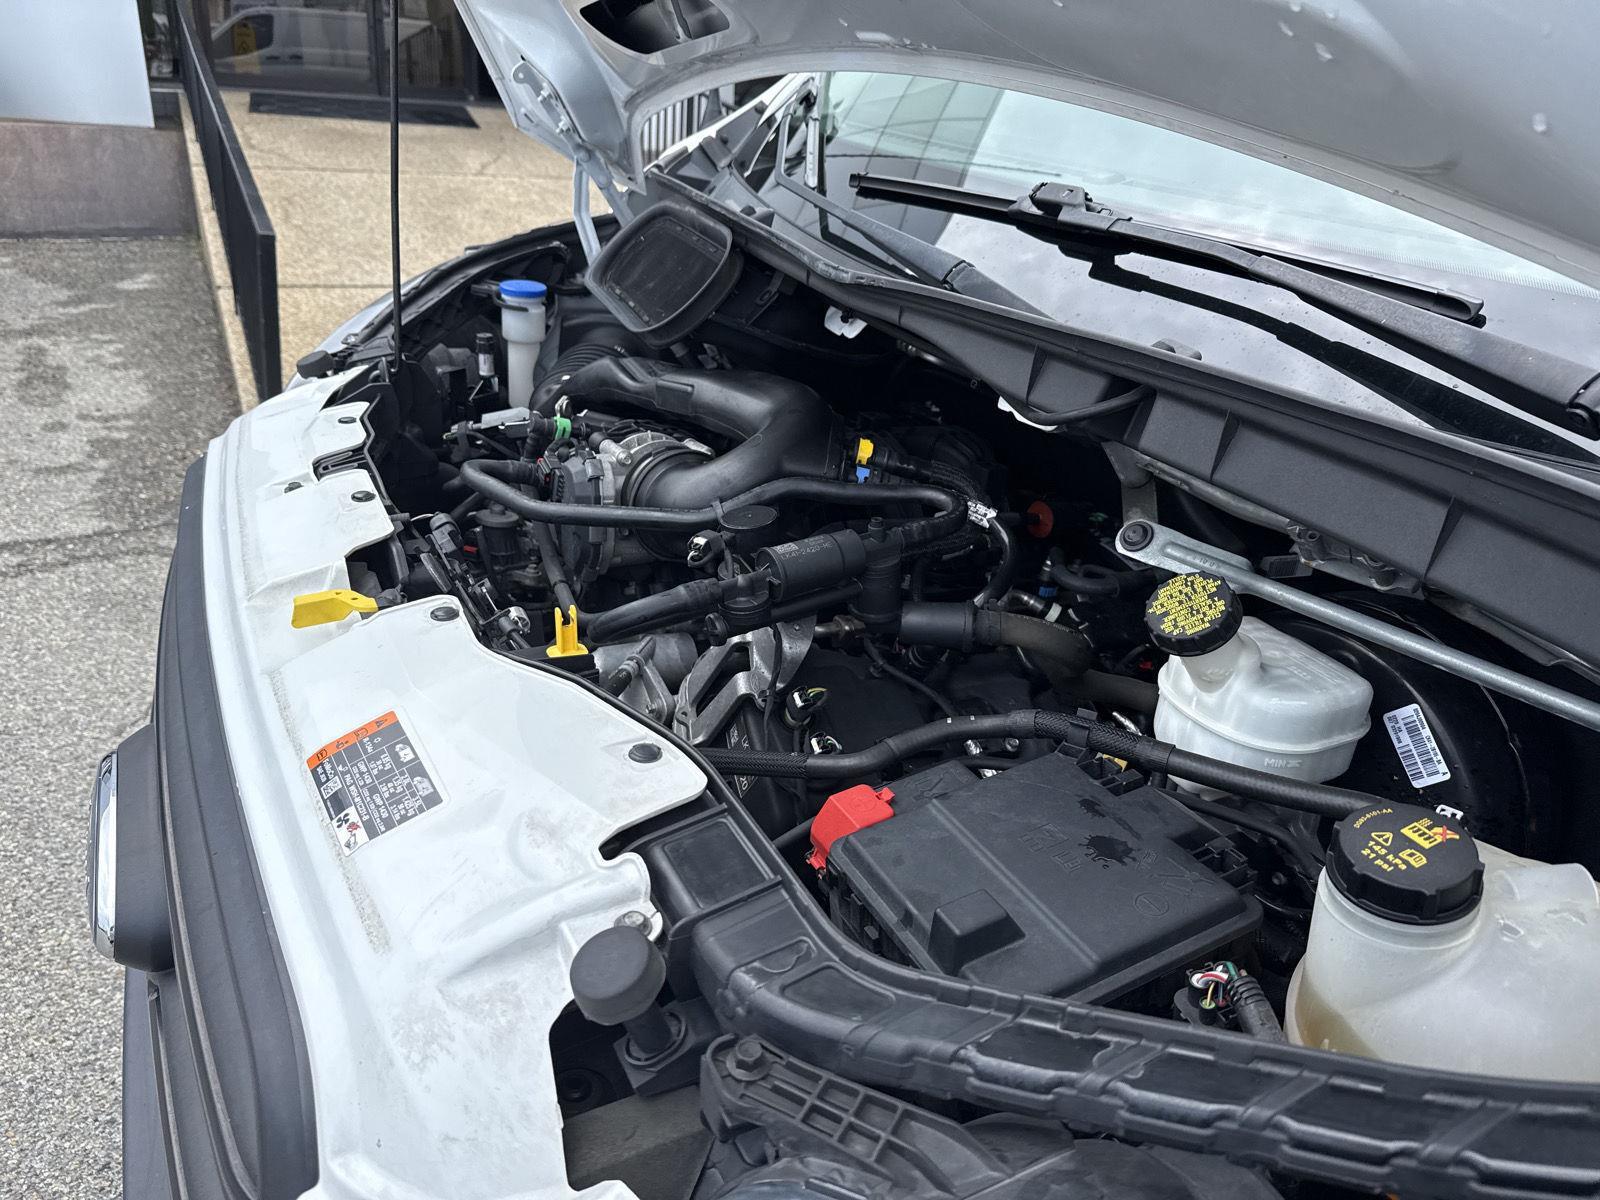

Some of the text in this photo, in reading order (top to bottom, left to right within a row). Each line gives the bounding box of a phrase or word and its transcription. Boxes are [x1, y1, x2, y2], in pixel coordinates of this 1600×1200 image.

[321, 758, 335, 778] FoMoCo
[1264, 758, 1286, 768] MIN
[1360, 848, 1394, 872] 21 psi
[1368, 841, 1407, 870] 145 kPa
